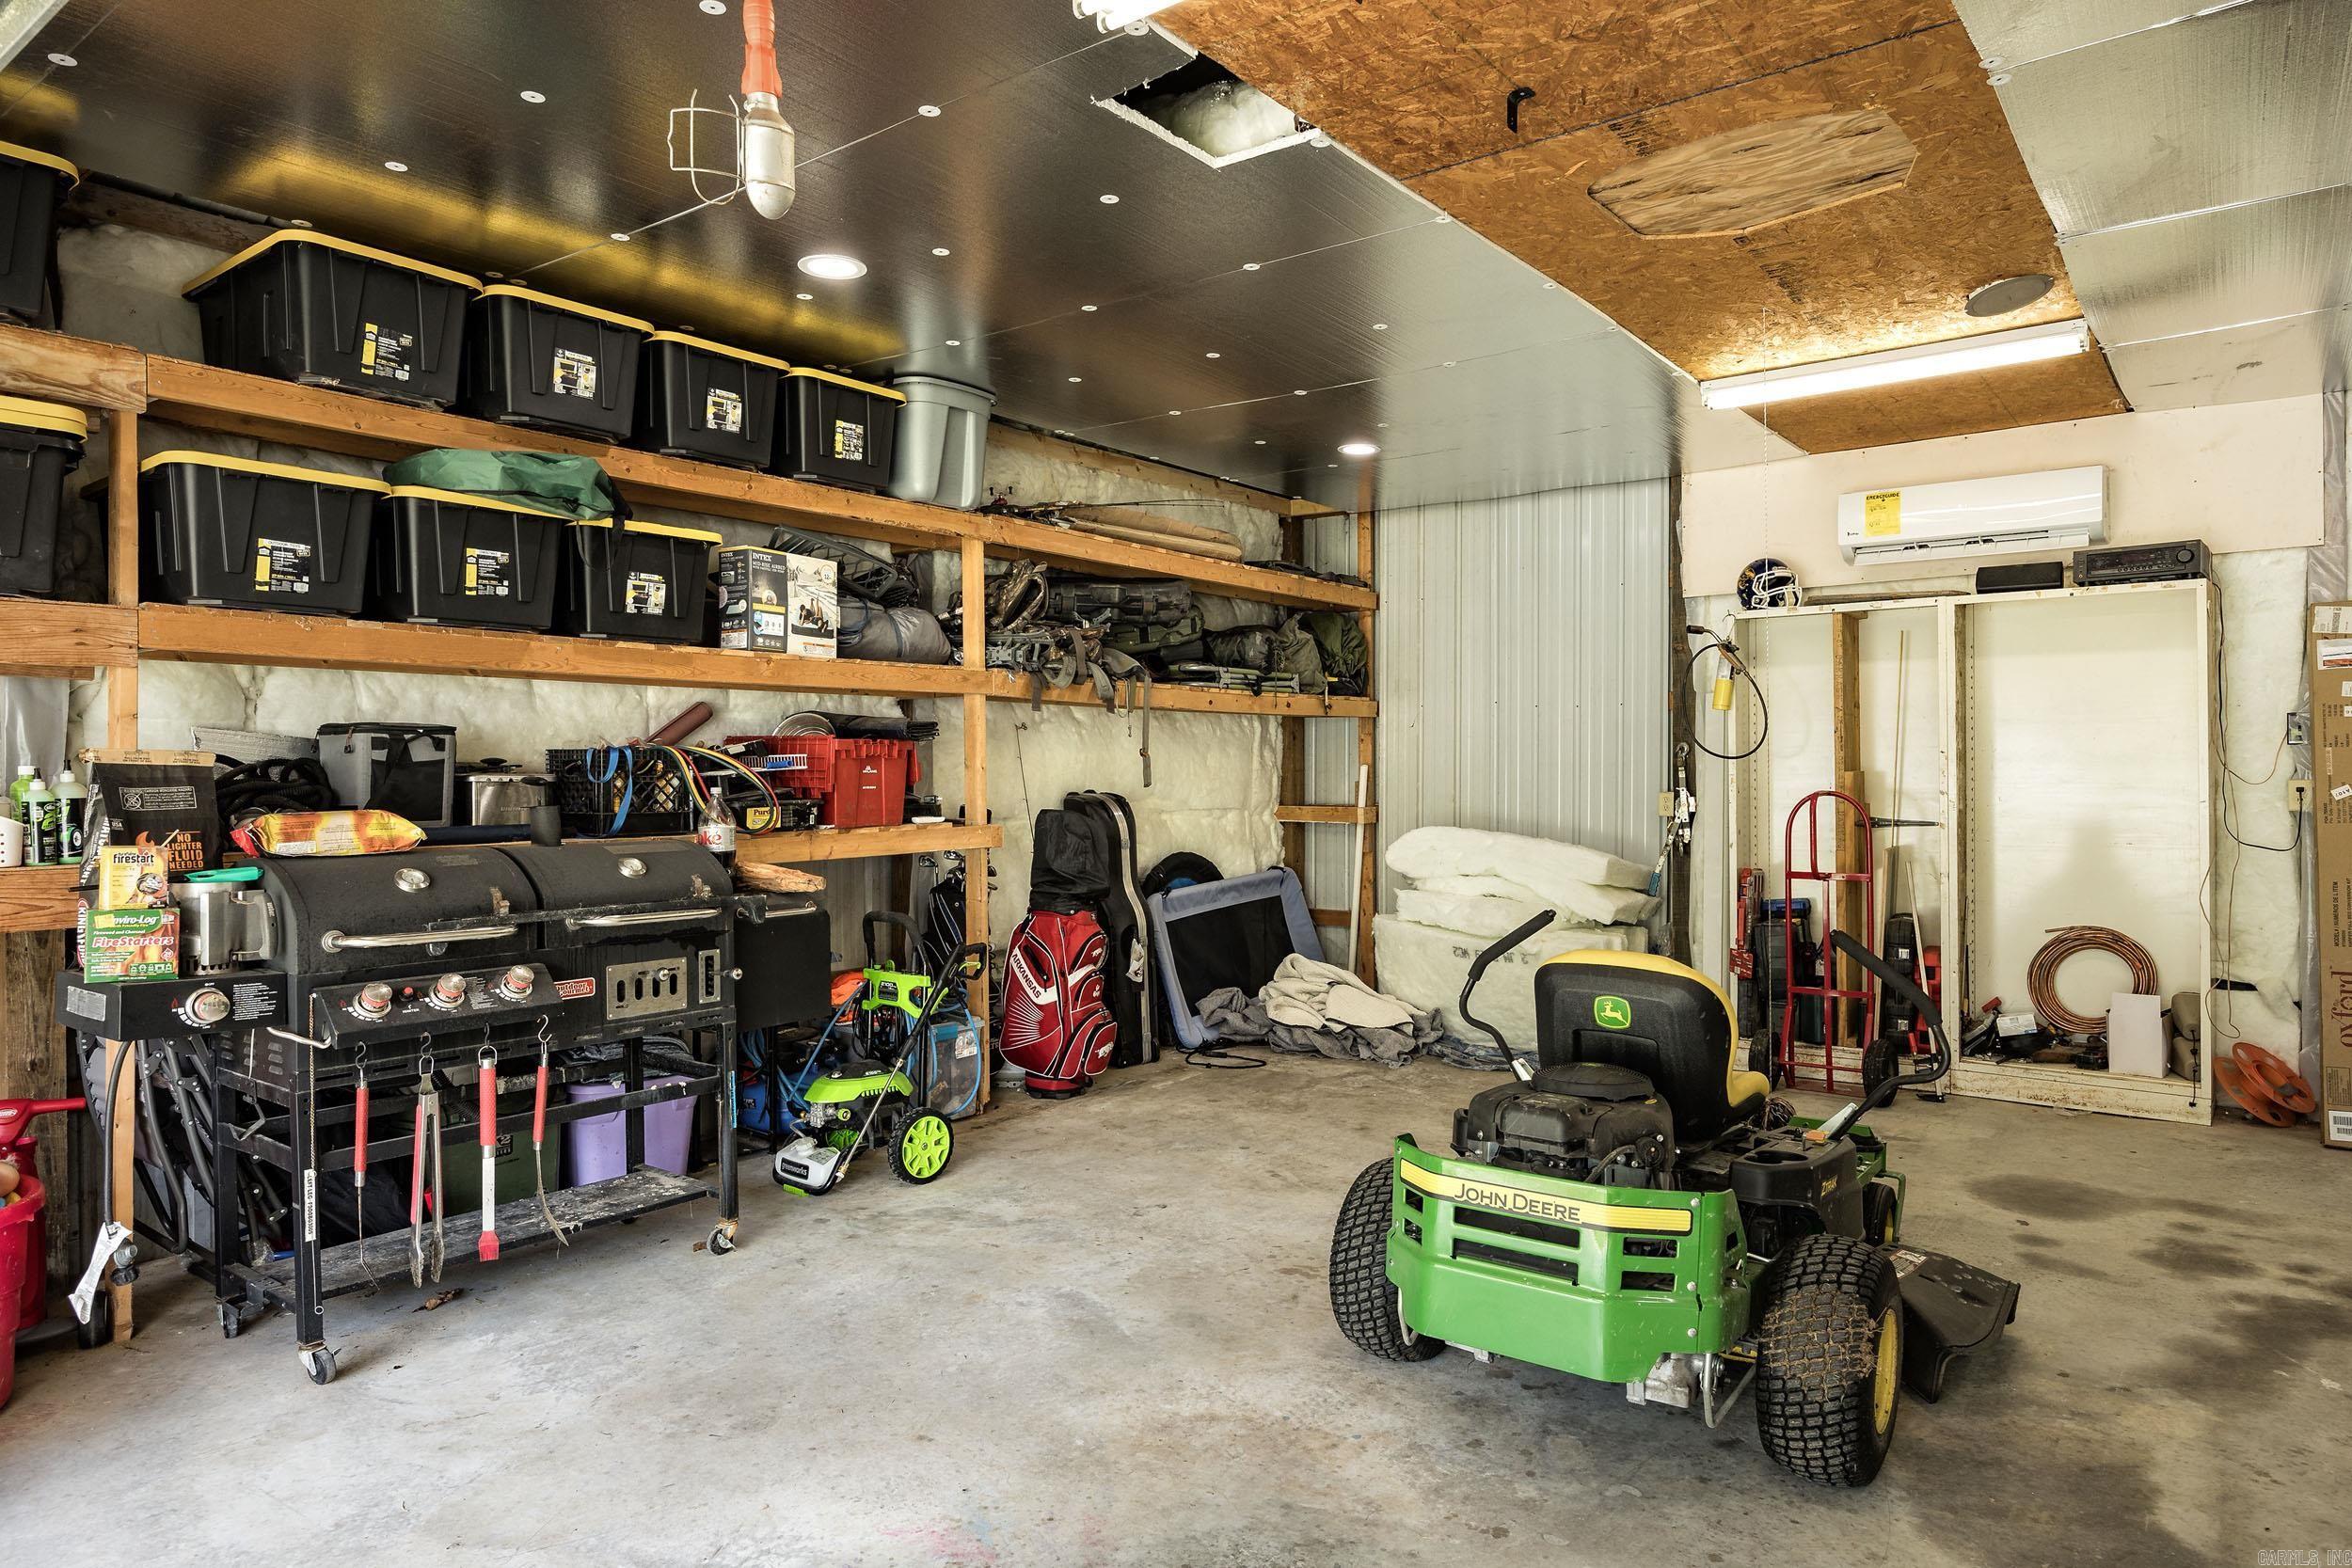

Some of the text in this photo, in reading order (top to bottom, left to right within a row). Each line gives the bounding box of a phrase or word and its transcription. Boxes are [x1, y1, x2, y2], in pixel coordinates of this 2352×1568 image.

[753, 552, 772, 562] INTEX
[176, 833, 192, 842] NO
[167, 842, 202, 850] LIGHTER
[113, 852, 154, 863] firestart
[168, 849, 203, 861] FLUID
[169, 860, 204, 869] NEEDED
[113, 914, 157, 926] nviro-Log
[91, 935, 174, 948] FireStarters
[1012, 954, 1041, 999] ARKANSAS
[1454, 1183, 1581, 1222] JOHN DEERE
